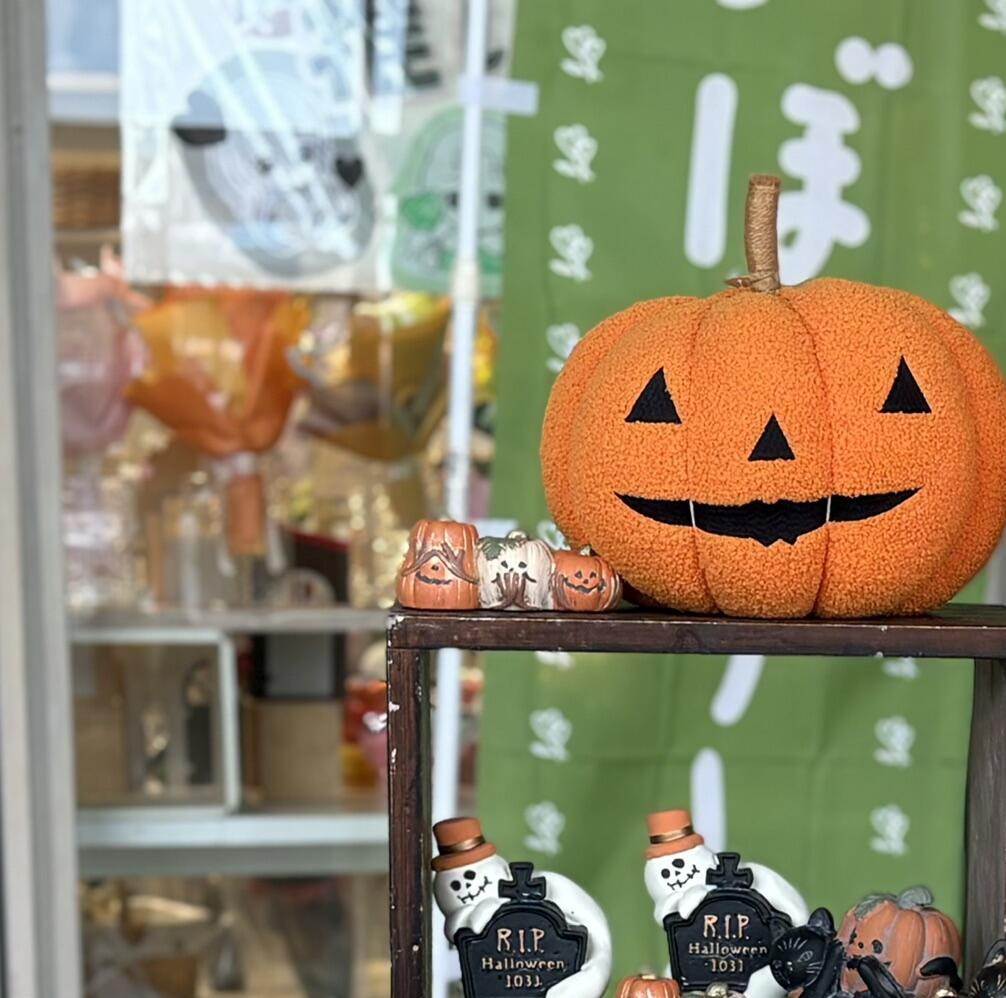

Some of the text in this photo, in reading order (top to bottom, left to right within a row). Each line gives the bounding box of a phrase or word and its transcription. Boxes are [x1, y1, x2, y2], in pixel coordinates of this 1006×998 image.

[688, 942, 768, 955] Halloween
[481, 957, 566, 970] Halloween
[711, 959, 744, 973] 1031
[505, 975, 542, 988] 1031
